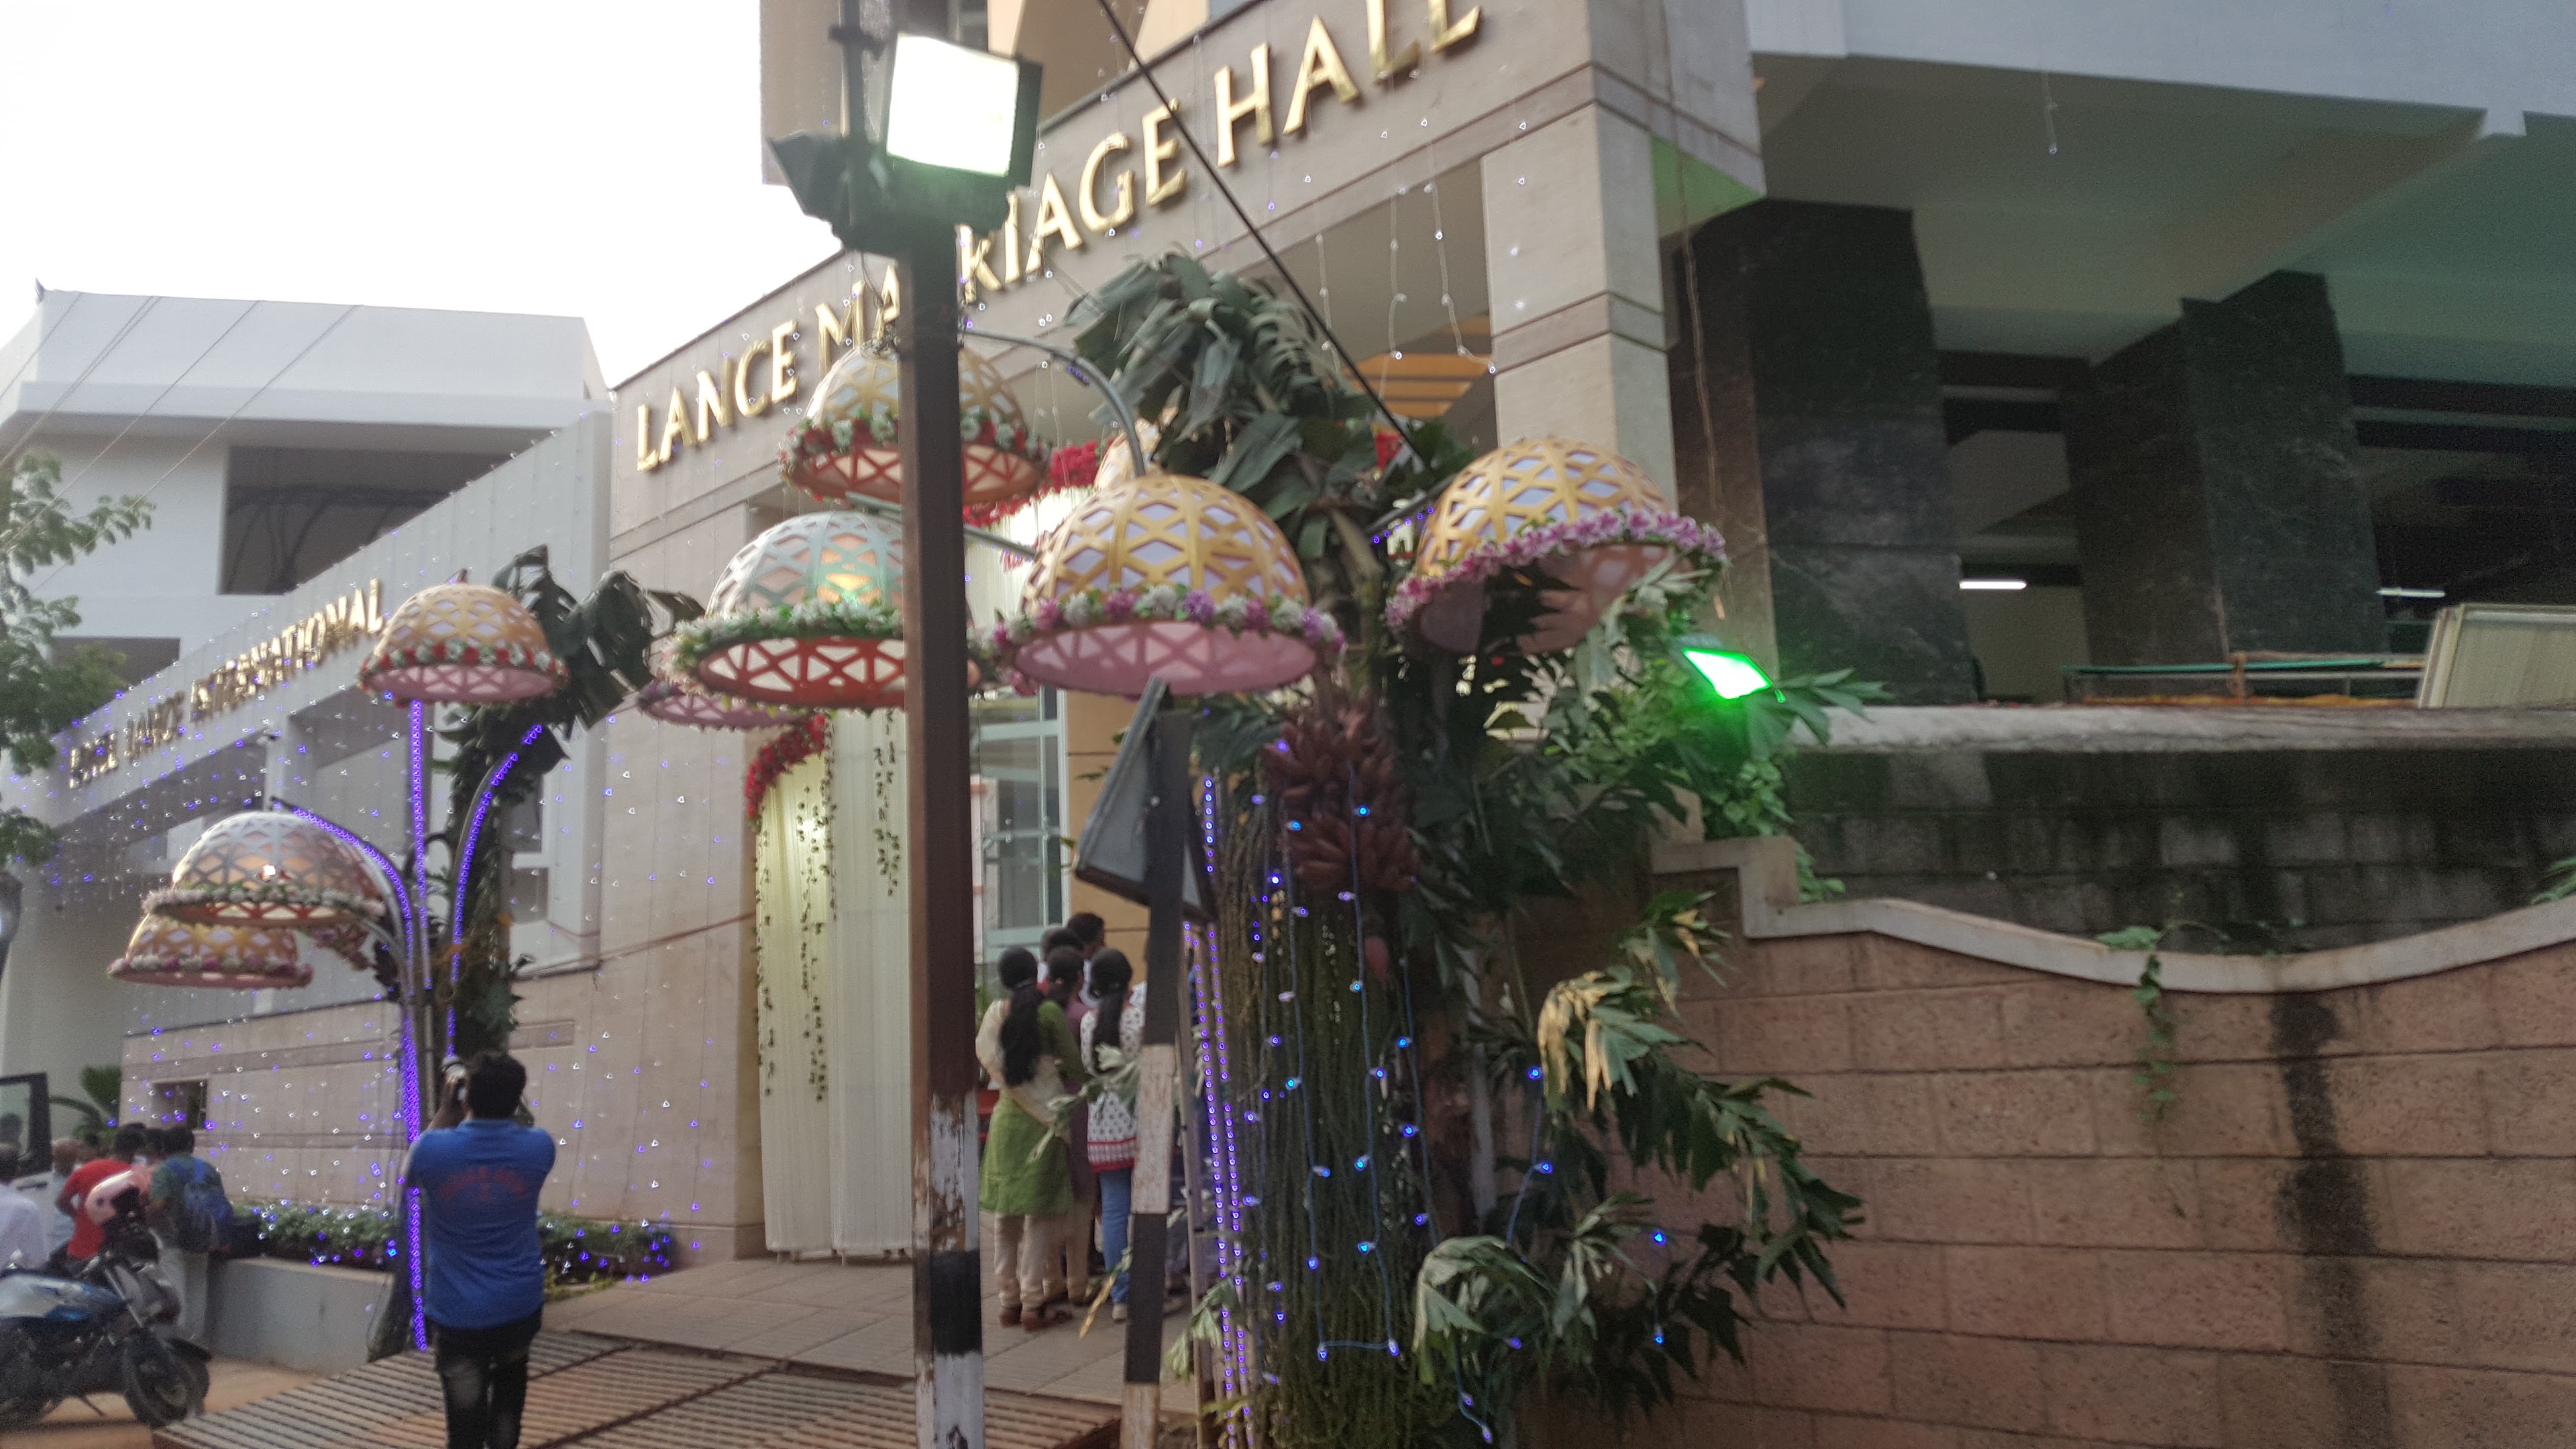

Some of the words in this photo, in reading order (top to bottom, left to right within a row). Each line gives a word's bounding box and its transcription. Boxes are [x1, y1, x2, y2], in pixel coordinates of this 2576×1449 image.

[636, 321, 798, 471] LANCE
[814, 98, 1187, 374] MARIAGE
[1214, 0, 1480, 168] HALL
